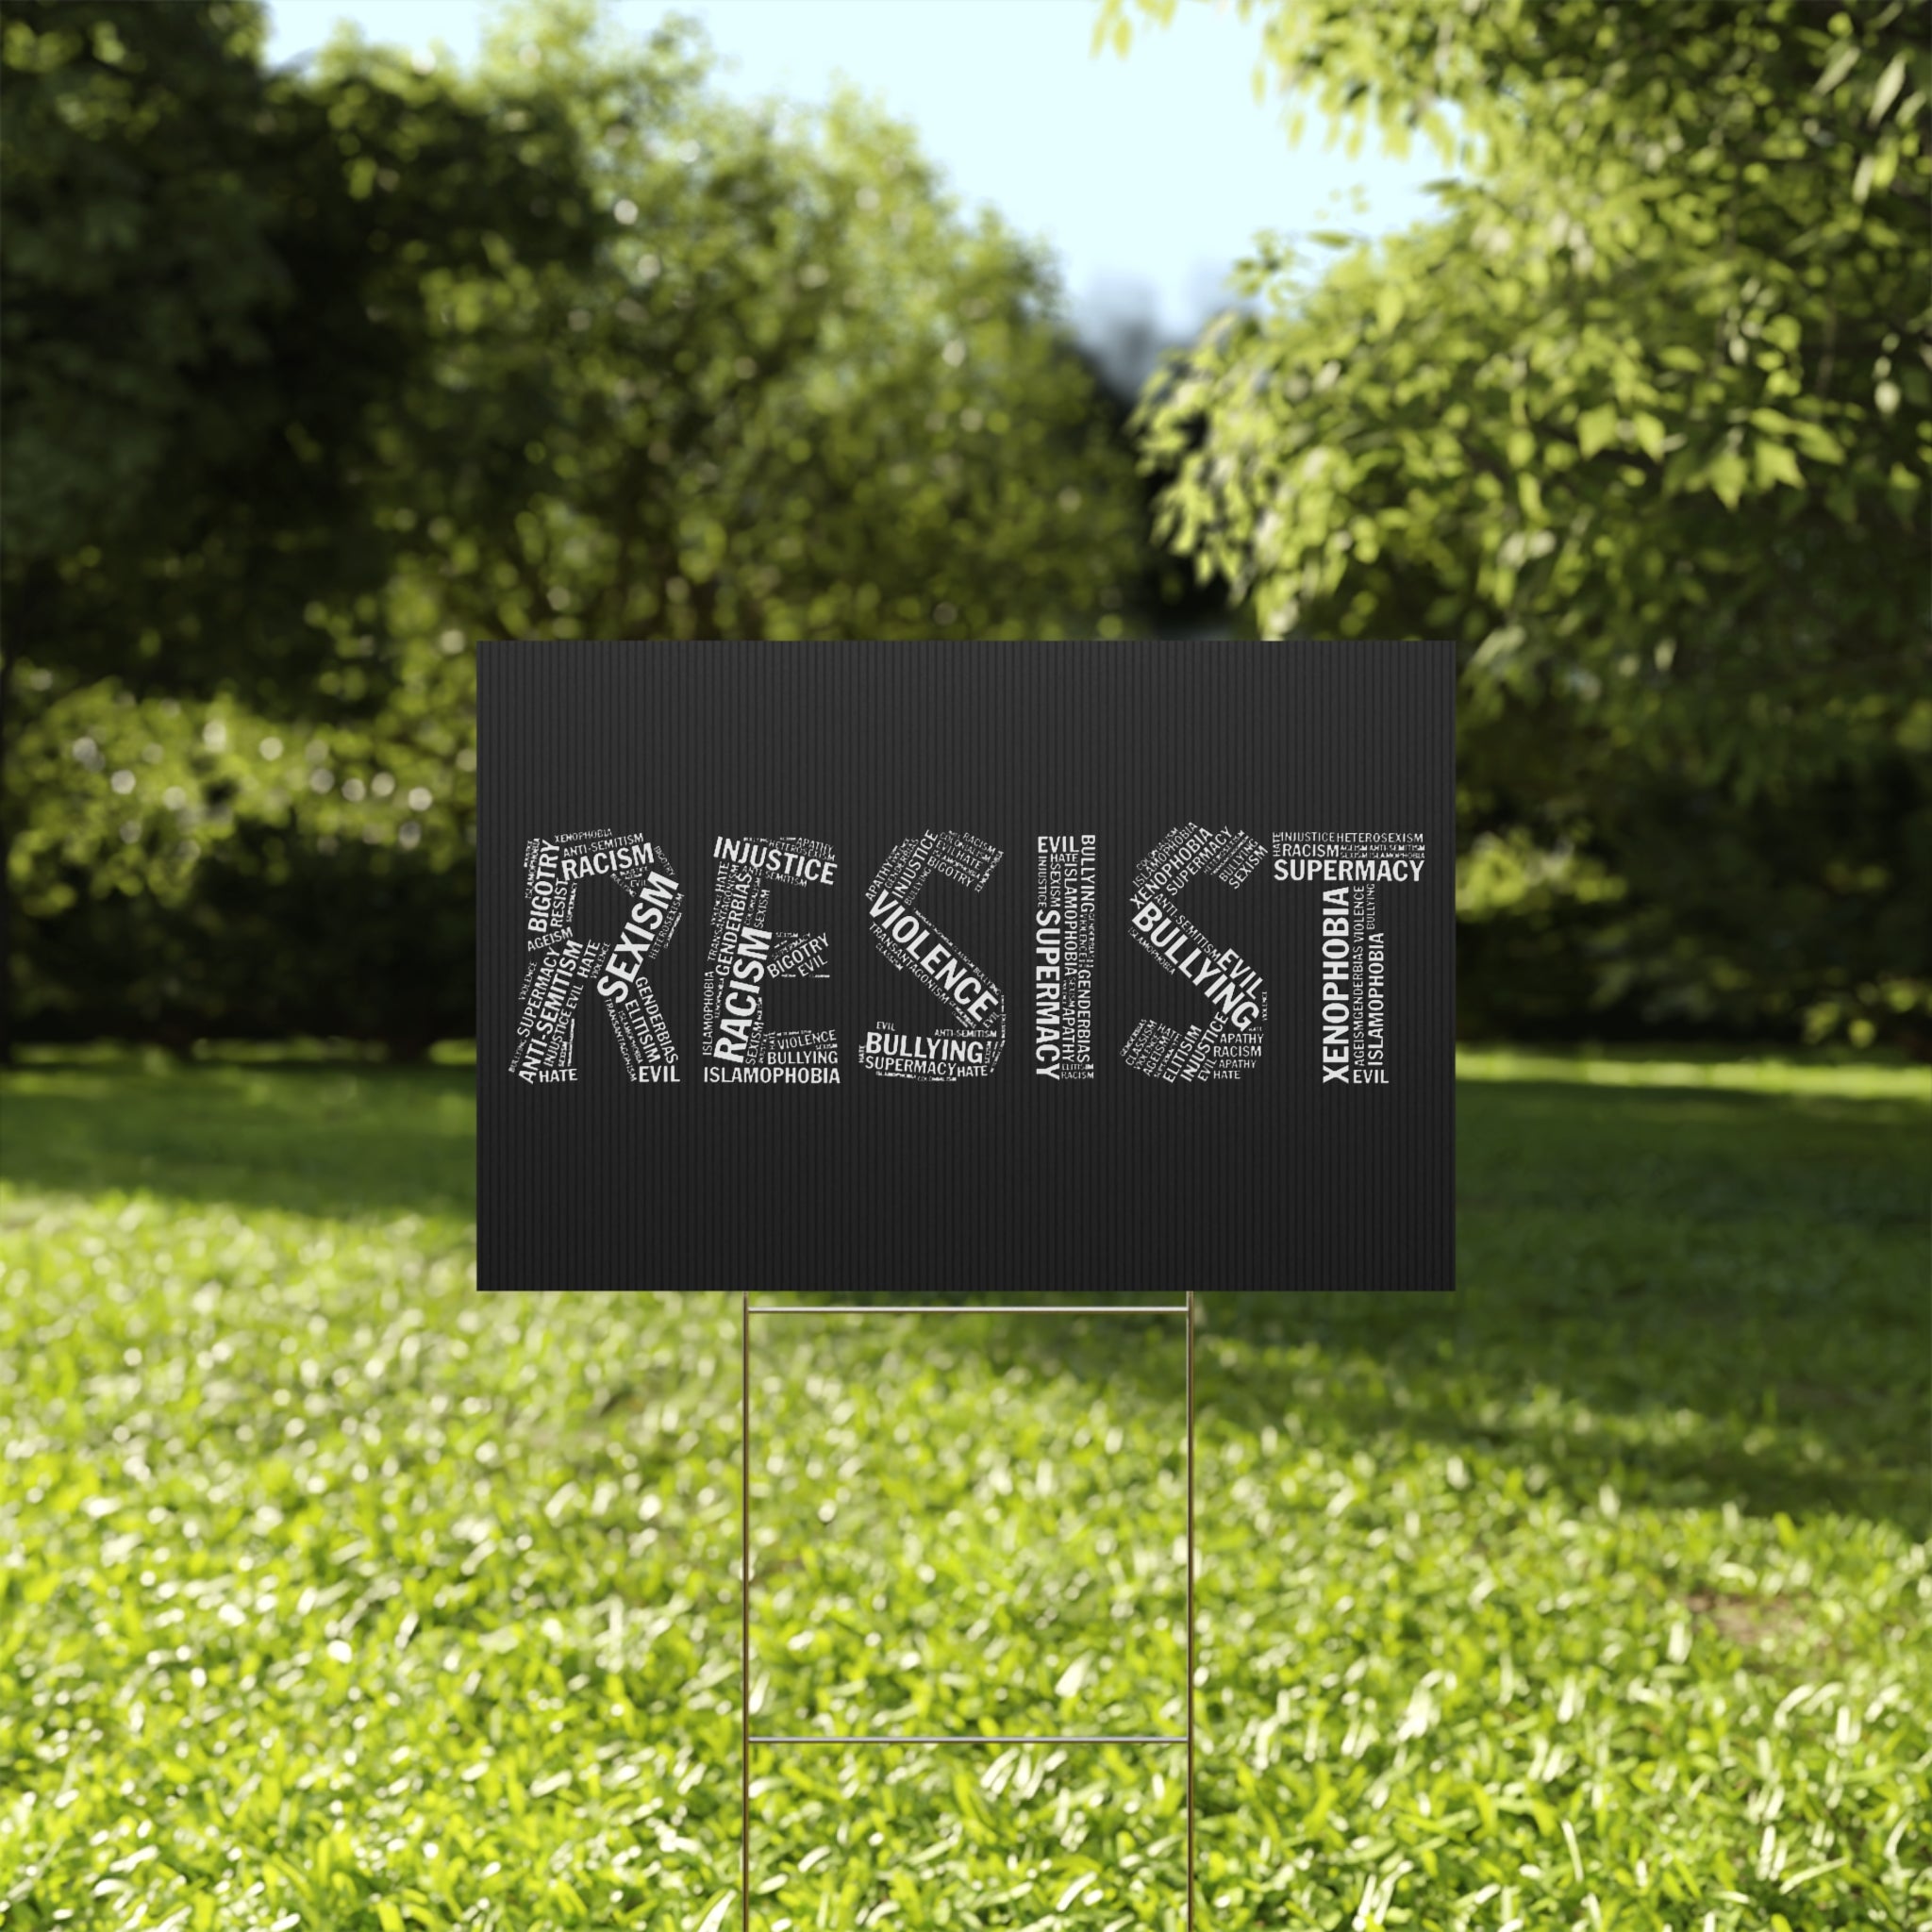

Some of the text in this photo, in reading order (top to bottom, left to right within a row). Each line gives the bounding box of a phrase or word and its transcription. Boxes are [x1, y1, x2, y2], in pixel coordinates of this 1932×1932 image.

[563, 833, 643, 858] ANTI-SEMITISM
[1038, 836, 1079, 853] EVIL
[1050, 853, 1079, 862] HATE
[1132, 822, 1198, 888] ISLAMOPHOBIA
[1273, 831, 1281, 857] HATE
[1281, 831, 1335, 842] INJUSTICE
[1283, 843, 1340, 858] RACISM
[1337, 832, 1424, 843] HETEROSEXISM
[561, 842, 654, 881] RACISM
[713, 836, 838, 885] INJUSTICE
[714, 860, 729, 892] HATE
[865, 859, 892, 901] APATHY
[891, 829, 939, 899] INJUSTICE
[927, 856, 974, 888] BIGOTRY
[1038, 856, 1047, 908] INJUSTICE
[1081, 834, 1096, 912] BULLYING
[1129, 827, 1213, 909] XENOPHOBIA
[1166, 825, 1232, 896] SUPERMACY
[1219, 838, 1258, 882] BULLYING
[1228, 844, 1269, 890] SEXISM
[1274, 858, 1425, 882] SUPERMACY
[528, 839, 559, 932] BIGOTRY
[550, 877, 568, 927] RESIST
[1050, 862, 1060, 907] SEXISM
[715, 873, 752, 976] GENDERBIAS
[754, 889, 770, 928] SEXISM
[1064, 863, 1077, 976] ISLAMOPHOBIA
[1154, 893, 1222, 961] ANTI-SEMITISM
[1353, 885, 1365, 943] VIOLENCE
[508, 822, 1425, 1087] RESIST
[528, 926, 573, 952] AGEISM
[576, 939, 601, 978] HATE
[596, 871, 679, 1003] SEXISM
[766, 932, 829, 978] BIGOTRY
[869, 889, 999, 1023] VIOLENCE
[797, 955, 828, 976] EVIL
[869, 922, 950, 1004] TRANSANTAGONISM
[1131, 901, 1260, 1032] BULLYING
[1216, 947, 1263, 1000] EVIL
[1322, 886, 1350, 1084] XENOPHOBIA
[1352, 945, 1364, 1019] GENDERBIAS
[517, 946, 560, 1038] SUPERMACY
[519, 940, 583, 1085] ANTI-SEMITISM
[566, 985, 583, 1009] EVIL
[702, 971, 714, 1056] ISLAMOPHOBIA
[713, 925, 773, 1063] RACISM
[1036, 908, 1060, 1080] SUPERMACY
[1367, 932, 1384, 1066] ISLAMOPHOBIA
[543, 1008, 572, 1067] INJUSTICE
[635, 976, 679, 1064] GENDERBIAS
[876, 1021, 896, 1031] EVIL
[1062, 1007, 1075, 1062] APATHY
[1077, 969, 1091, 1063] GENDERBIAS
[1220, 1033, 1264, 1044] APATHY
[745, 1022, 764, 1065] SEXISM
[766, 1050, 838, 1064] BULLYING
[776, 1029, 838, 1050] VIOLENCE
[866, 1031, 984, 1064] BULLYING
[1143, 1035, 1170, 1077] AGEISM
[1180, 1011, 1229, 1083] INJUSTICE
[1213, 1045, 1262, 1058] RACISM
[1353, 1020, 1365, 1066] AGEISM
[539, 1068, 578, 1083] HATE
[639, 1065, 680, 1082] EVIL
[704, 1066, 841, 1084] ISLAMOPHOBIA
[864, 1056, 957, 1076] SUPERMACY
[957, 1065, 988, 1077] HATE
[1197, 1058, 1217, 1082] EVIL
[1213, 1071, 1241, 1079] HATE
[1219, 1059, 1257, 1069] APATHY
[1353, 1069, 1390, 1084] EVIL
